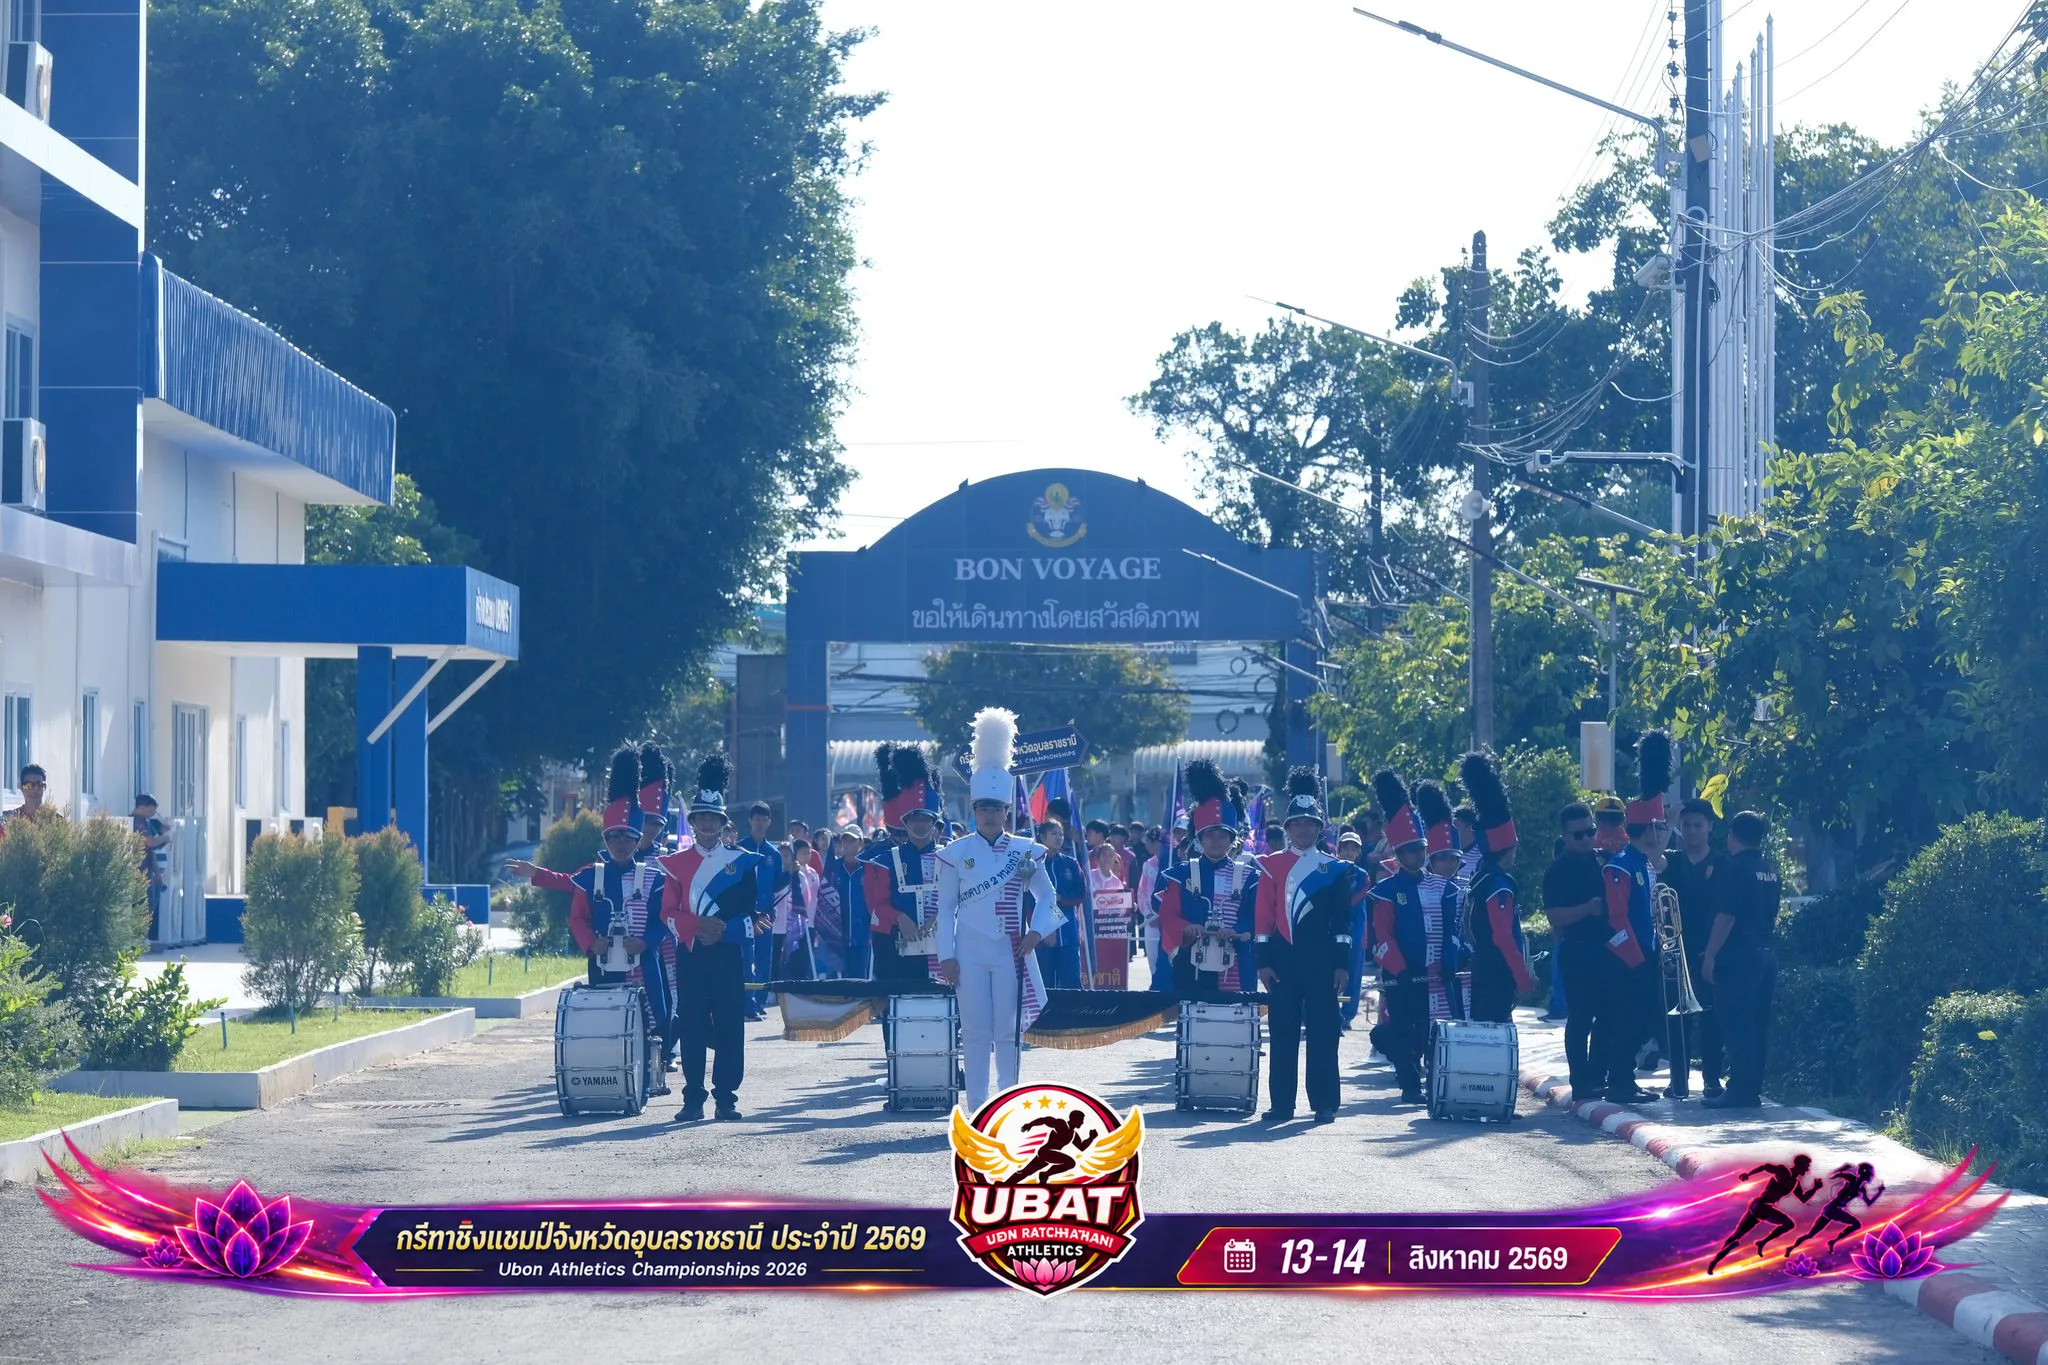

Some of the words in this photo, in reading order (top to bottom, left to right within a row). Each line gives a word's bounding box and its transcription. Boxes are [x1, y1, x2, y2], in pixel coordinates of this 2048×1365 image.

[955, 558, 1023, 581] BON
[1031, 556, 1162, 581] VOYAGE
[911, 597, 1200, 630] ขอให้เดินทางโดยสวัสดิภาพ
[1024, 750, 1077, 764] CHAMPIONSHIPS
[990, 875, 999, 886] 2
[996, 850, 1021, 880] หนองบัว
[582, 1076, 619, 1086] YAMAHA
[1468, 1083, 1495, 1092] YAMAHA
[911, 1096, 947, 1104] YAMAHA
